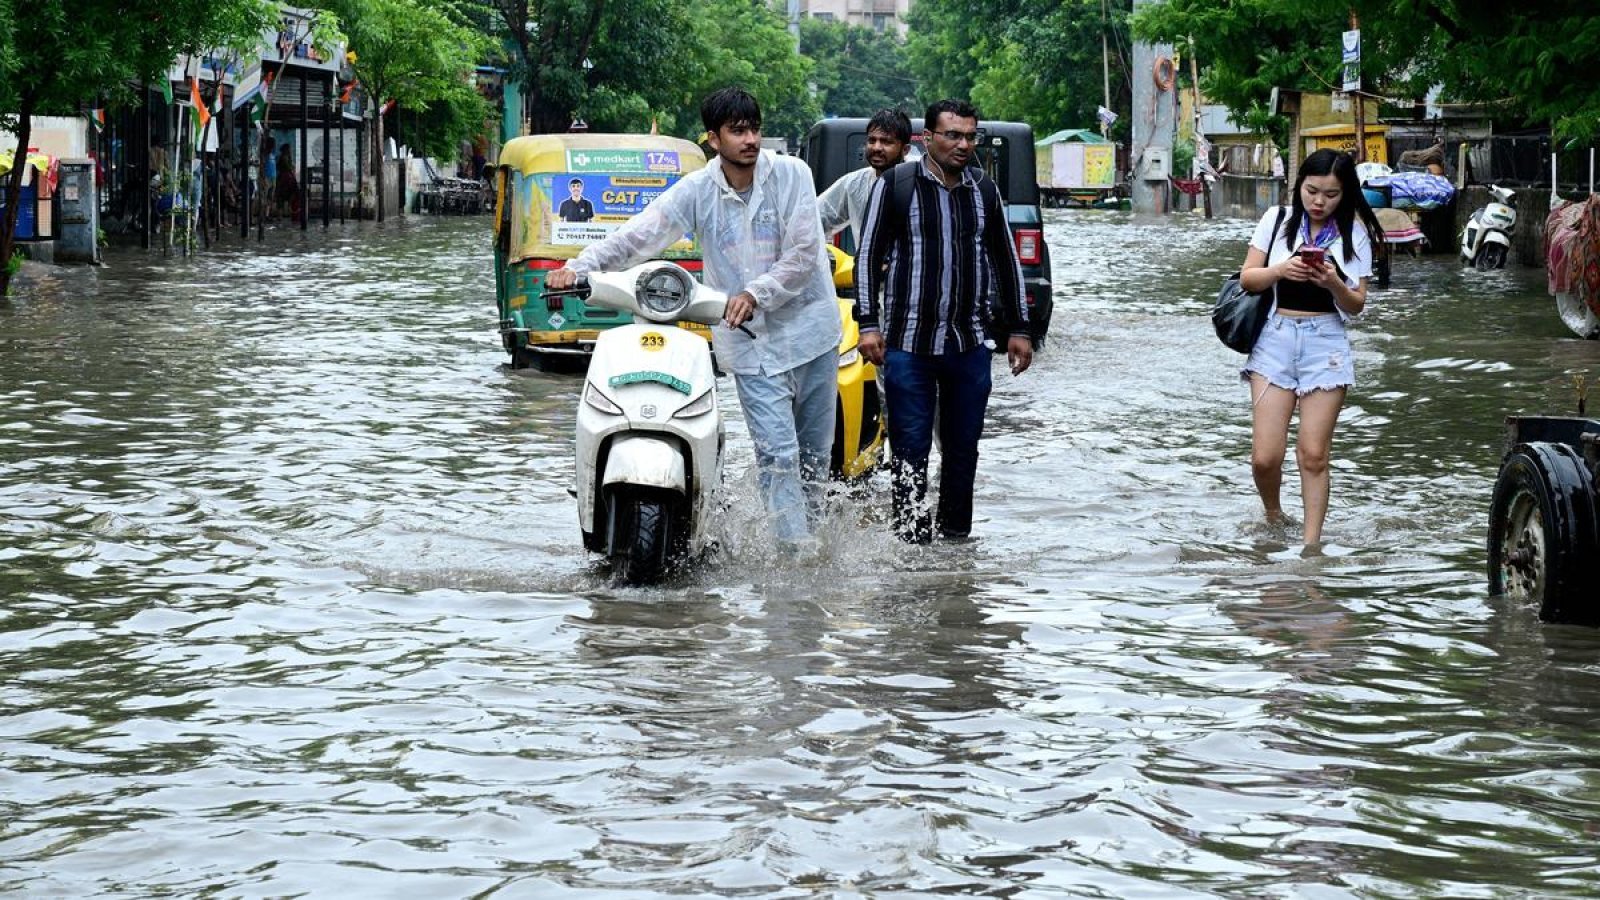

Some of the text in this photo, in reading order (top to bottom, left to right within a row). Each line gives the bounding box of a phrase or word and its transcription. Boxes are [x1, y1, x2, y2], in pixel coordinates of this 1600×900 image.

[593, 154, 641, 164] medkart
[647, 152, 676, 165] 17%
[602, 191, 639, 204] CAT
[641, 336, 665, 346] 233
